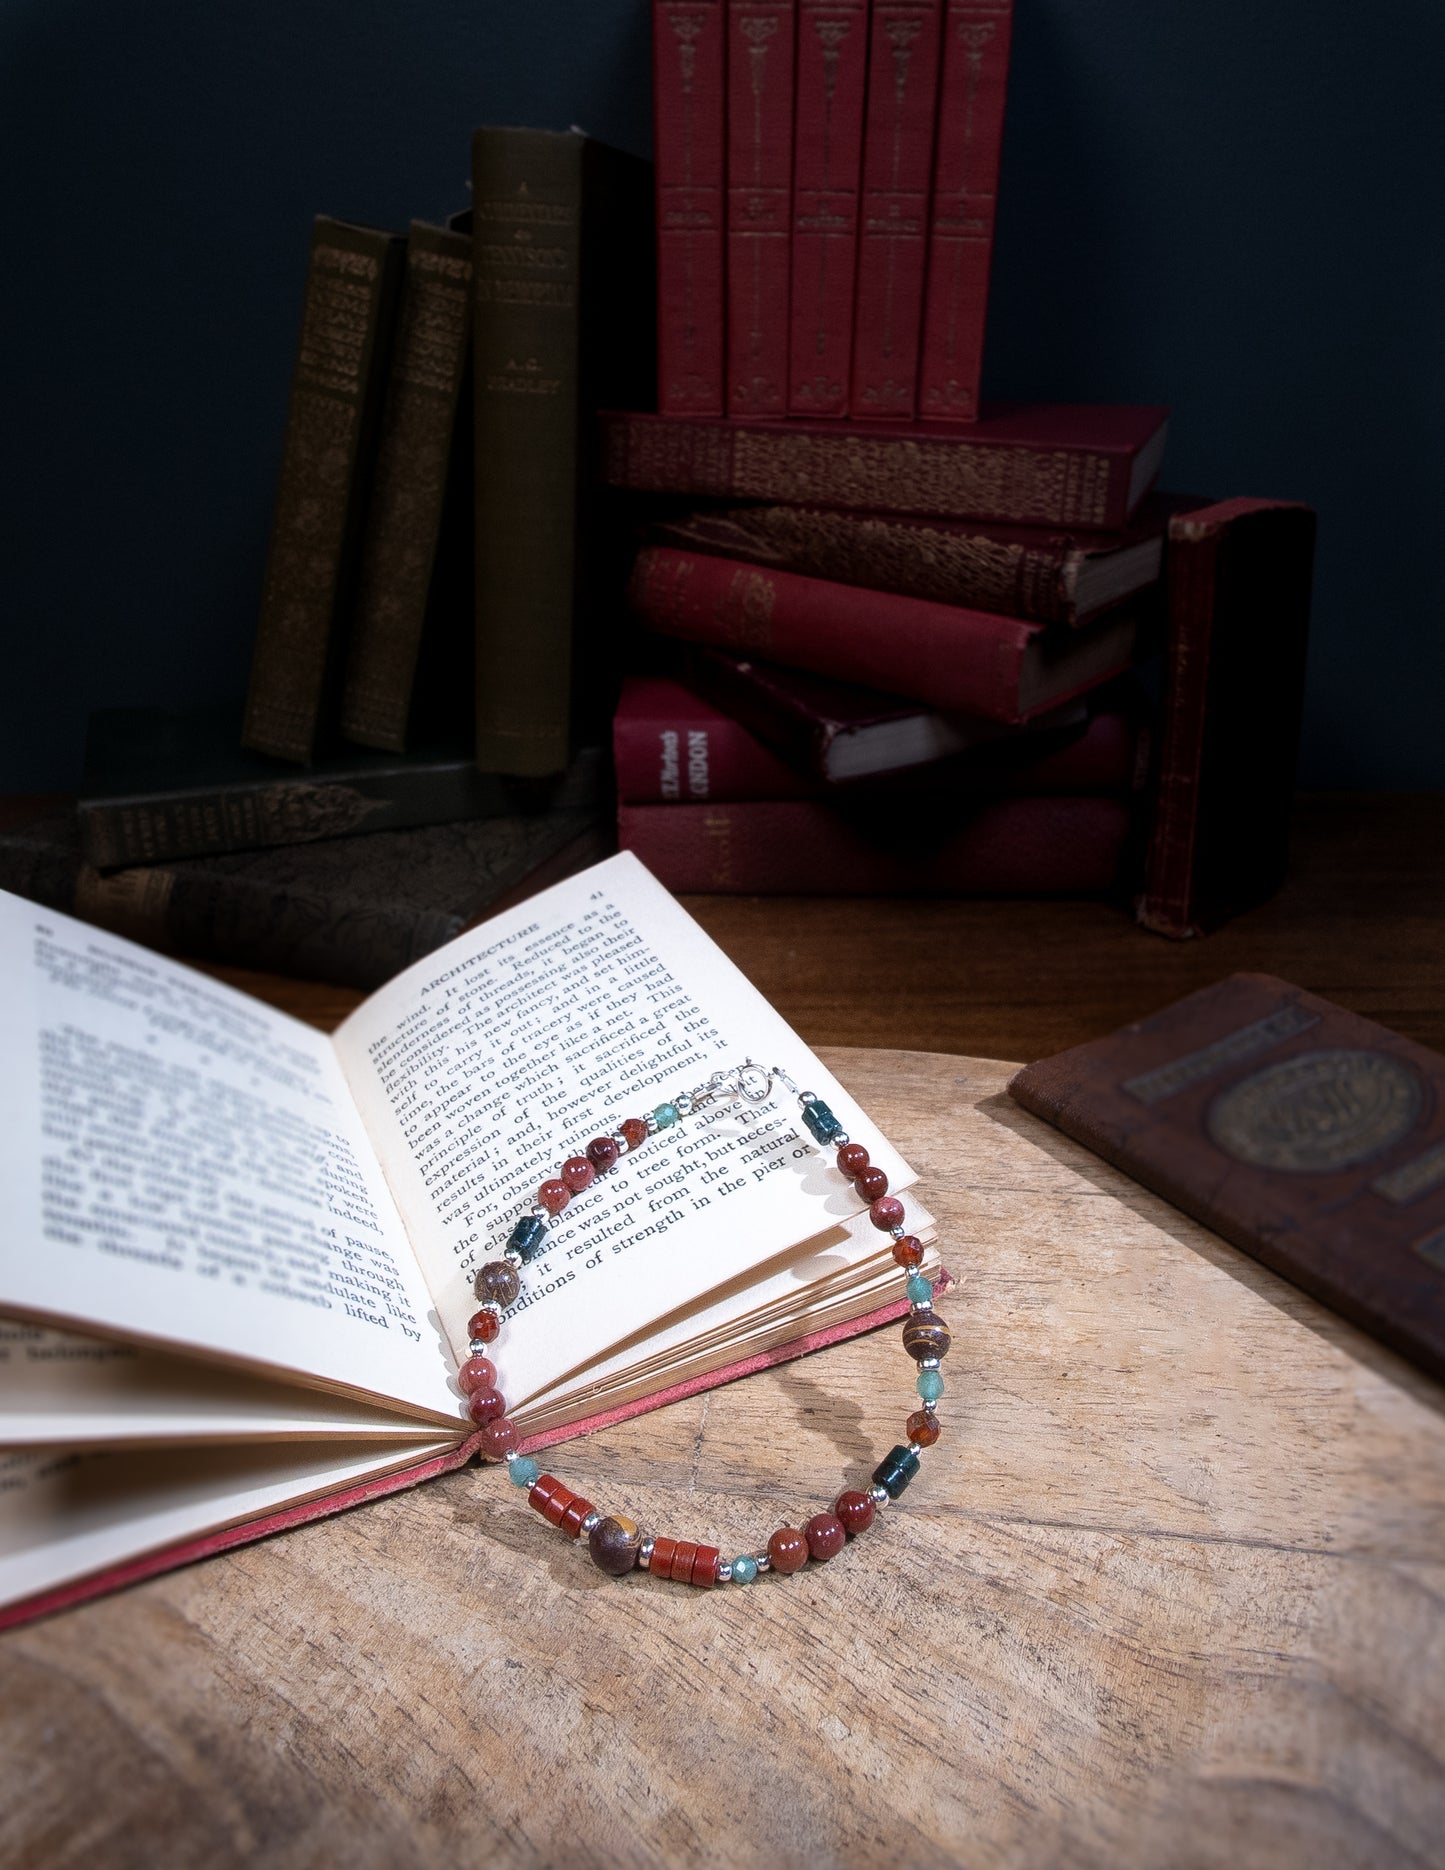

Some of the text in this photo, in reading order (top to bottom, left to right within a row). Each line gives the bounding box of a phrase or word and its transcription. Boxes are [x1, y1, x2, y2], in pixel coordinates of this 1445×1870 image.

[688, 731, 709, 797] ONDON
[421, 923, 540, 996] ARCHITECTURE
[590, 891, 603, 900] 41
[368, 1036, 387, 1054] the
[396, 1005, 431, 1030] wind.
[445, 987, 458, 997] It
[464, 969, 490, 986] lost
[497, 955, 515, 966] its
[525, 923, 574, 952] essence
[583, 911, 599, 921] as
[372, 911, 621, 1065] structure of stone. Reduced to the
[377, 919, 628, 1074] slenderness of threads, it began to
[380, 928, 634, 1084] be considered as possessing also their
[386, 935, 643, 1095] flexibility. The architect was pleased
[390, 947, 650, 1104] with this his new fancy, and set him-
[395, 1090, 417, 1116] self
[424, 1079, 438, 1091] to
[446, 1049, 482, 1075] carry
[489, 1039, 502, 1048] it
[552, 994, 580, 1014] and
[586, 985, 601, 995] in
[608, 976, 618, 984] a
[624, 956, 659, 975] little
[399, 963, 666, 1126] time, the bars of tracery were caused
[404, 973, 674, 1138] to appear to the eye as if they had
[408, 985, 683, 1150] been woven together like a net. This
[414, 995, 692, 1160] was a change which sacrificed a great
[419, 1125, 482, 1177] principle
[492, 1105, 507, 1122] of
[572, 1064, 586, 1074] it
[595, 1021, 667, 1063] sacrificed
[675, 1006, 700, 1021] the
[425, 1017, 710, 1186] expression of the qualities of the
[436, 1173, 485, 1213] results
[491, 1158, 509, 1172] in
[515, 1130, 553, 1156] their
[562, 1108, 594, 1130] first
[603, 1052, 708, 1106] development,
[715, 1040, 728, 1049] it
[507, 1121, 542, 1146] and,
[546, 1081, 611, 1121] however
[619, 1039, 693, 1081] delightful
[698, 1028, 719, 1042] its
[328, 1205, 384, 1236] indeed,
[441, 1201, 471, 1225] was
[474, 1148, 552, 1202] ultimately
[558, 1113, 622, 1150] ruinous.
[460, 1249, 476, 1269] of
[627, 1127, 689, 1167] noticed
[694, 1100, 743, 1130] above
[463, 1202, 498, 1228] For,
[501, 1161, 562, 1201] observe
[536, 1263, 553, 1277] it
[565, 1213, 636, 1261] resulted
[648, 1187, 691, 1213] from
[700, 1166, 729, 1185] the
[741, 1128, 800, 1165] natural
[577, 1209, 611, 1231] was
[612, 1192, 643, 1213] not
[645, 1160, 707, 1195] sought,
[705, 1140, 736, 1161] but
[735, 1118, 788, 1146] neces-
[610, 1180, 629, 1193] to
[636, 1158, 671, 1179] tree
[676, 1133, 722, 1158] form.
[735, 1101, 778, 1126] That
[321, 1227, 395, 1264] of pause,
[328, 1271, 411, 1308] making it
[341, 1260, 405, 1292] through
[453, 1233, 479, 1255] the
[499, 1269, 576, 1325] onditions
[585, 1249, 603, 1269] of
[611, 1209, 686, 1255] strength
[691, 1196, 712, 1211] in
[717, 1178, 747, 1196] the
[751, 1156, 786, 1182] pier
[792, 1144, 811, 1159] or
[344, 1303, 422, 1342] lifted by
